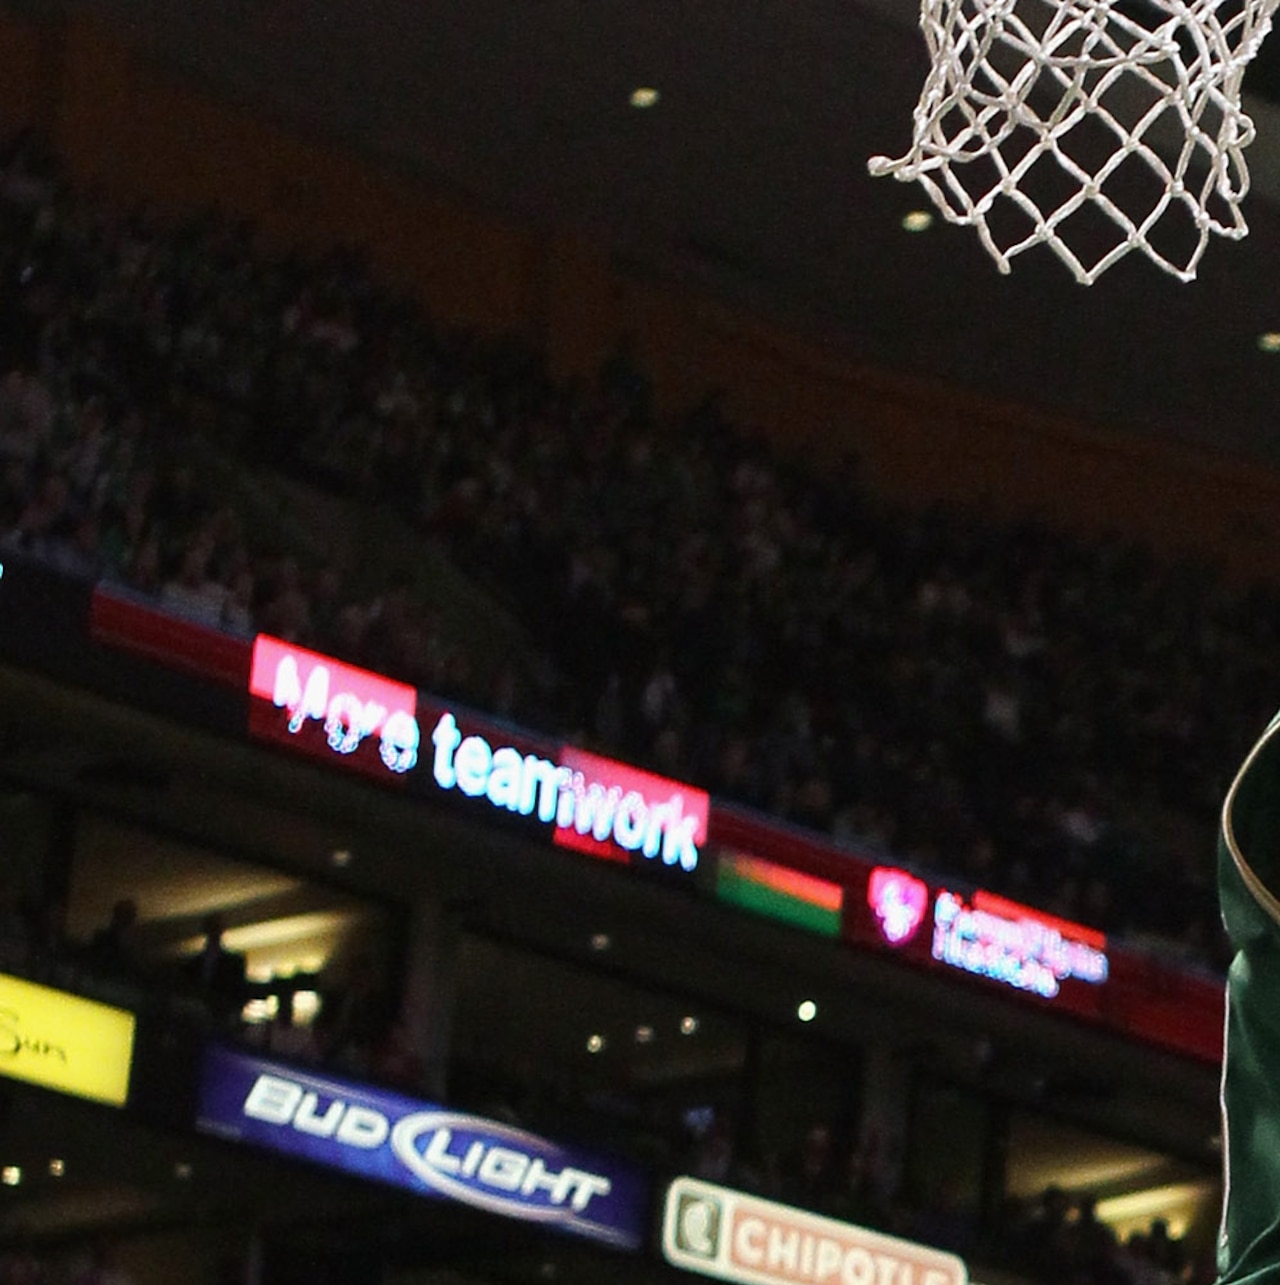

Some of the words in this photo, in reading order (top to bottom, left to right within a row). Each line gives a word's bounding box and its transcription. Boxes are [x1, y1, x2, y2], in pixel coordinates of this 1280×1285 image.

[271, 654, 421, 774] More
[432, 711, 699, 872] teamwork
[244, 1074, 390, 1149] BUD
[425, 1128, 612, 1212] LIGHT
